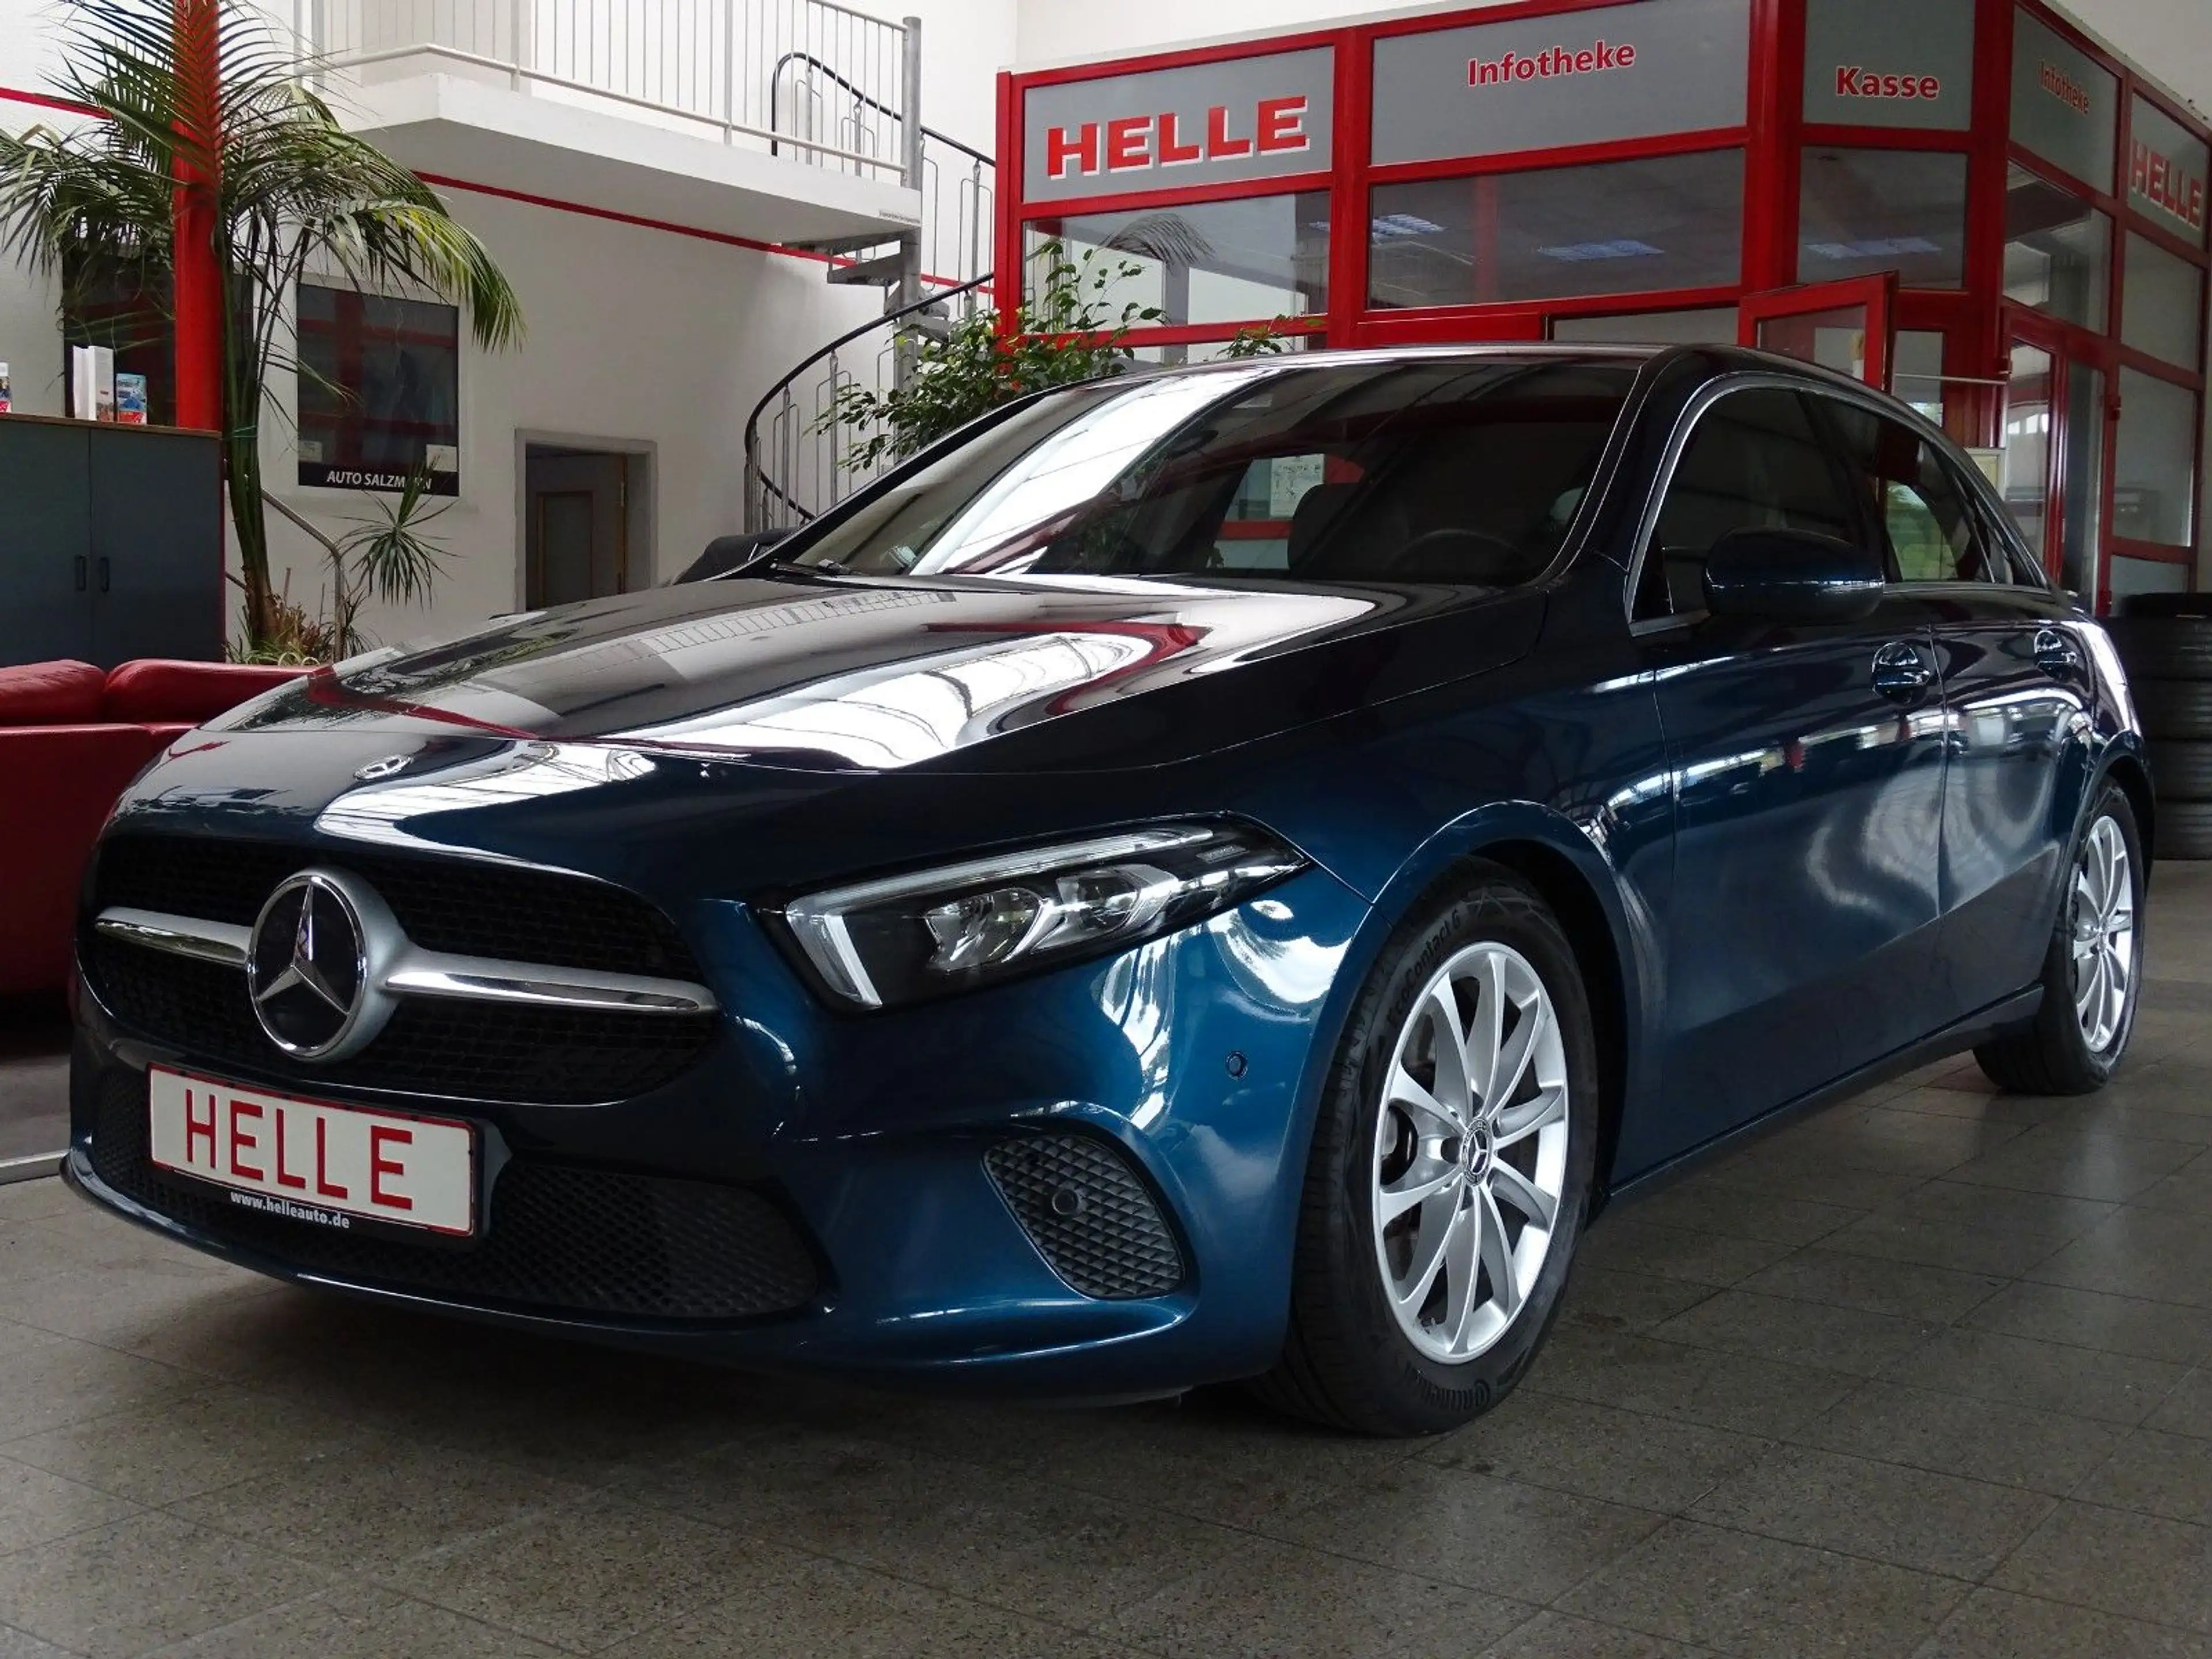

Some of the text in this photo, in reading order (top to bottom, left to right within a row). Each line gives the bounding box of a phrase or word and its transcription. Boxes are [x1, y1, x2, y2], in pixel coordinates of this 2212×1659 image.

[1467, 39, 1636, 88] Infotheke
[1835, 66, 1940, 100] Kasse
[2038, 59, 2090, 116] Infotheke
[1047, 95, 1310, 180] HELLE
[2131, 136, 2202, 231] HELLE
[326, 470, 432, 490] AUTO SALZMN
[185, 1089, 412, 1210] HELLE
[230, 1191, 350, 1229] www.helleauto.de
